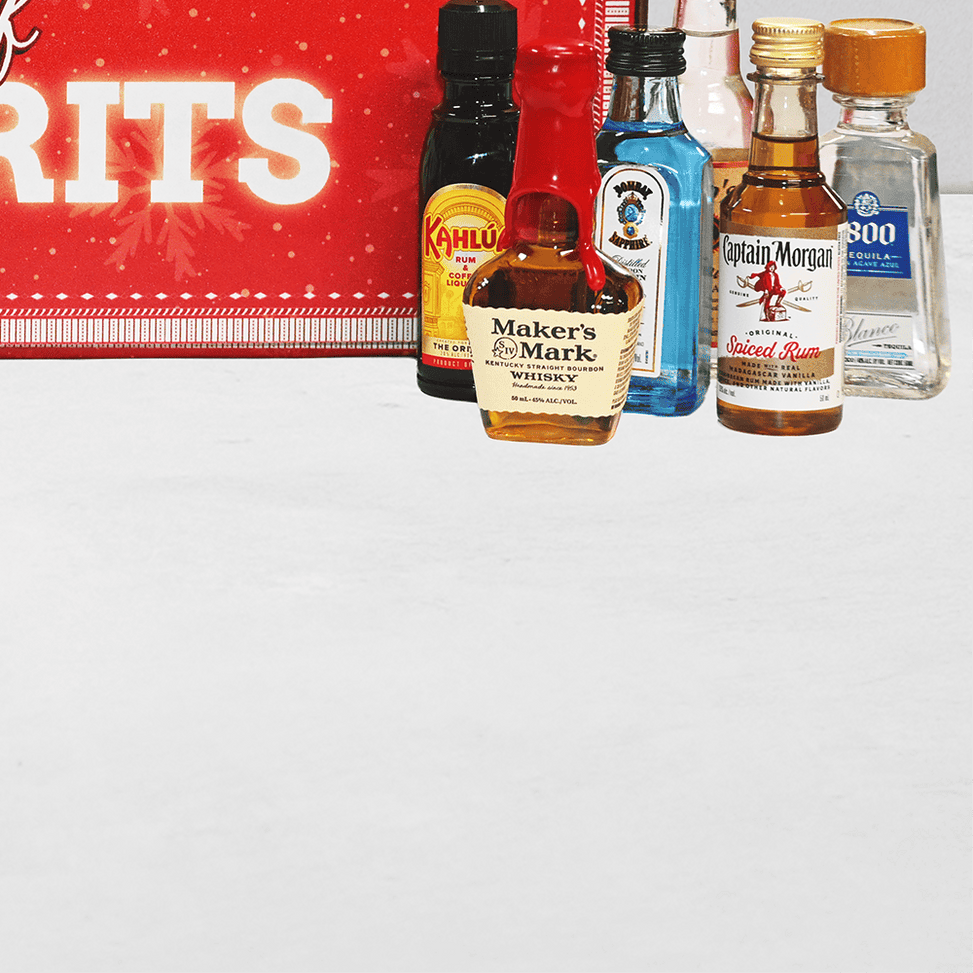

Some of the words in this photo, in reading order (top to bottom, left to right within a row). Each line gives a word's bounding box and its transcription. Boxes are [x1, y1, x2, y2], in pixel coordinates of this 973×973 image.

[612, 180, 654, 201] BOMBAY
[846, 221, 896, 246] 800
[608, 230, 652, 251] SAPPHIRE
[722, 234, 771, 268] Captain
[771, 240, 833, 272] Morgan
[848, 251, 891, 260] EQUILA
[455, 256, 476, 264] RUM
[612, 254, 651, 268] Distilled
[729, 289, 750, 298] GENUINE
[490, 317, 597, 341] Maker's
[748, 329, 794, 339] ORIGINAL
[433, 342, 450, 351] THE
[498, 340, 505, 348] S
[726, 334, 778, 358] Spiced
[778, 341, 821, 362] Rum
[504, 347, 516, 355] IV
[518, 341, 596, 363] Mark
[433, 358, 460, 367] PRODUCT
[485, 359, 524, 369] KENTUCKY
[526, 363, 565, 371] STRAIGHT
[741, 361, 761, 369] MADE
[729, 364, 779, 378] MADAGASCAR
[510, 370, 579, 383] WHISKY
[511, 381, 546, 391] Handmade
[546, 383, 563, 391] since
[804, 378, 830, 386] VANILLA
[745, 383, 767, 391] OTHER
[804, 384, 831, 392] FLAVORS
